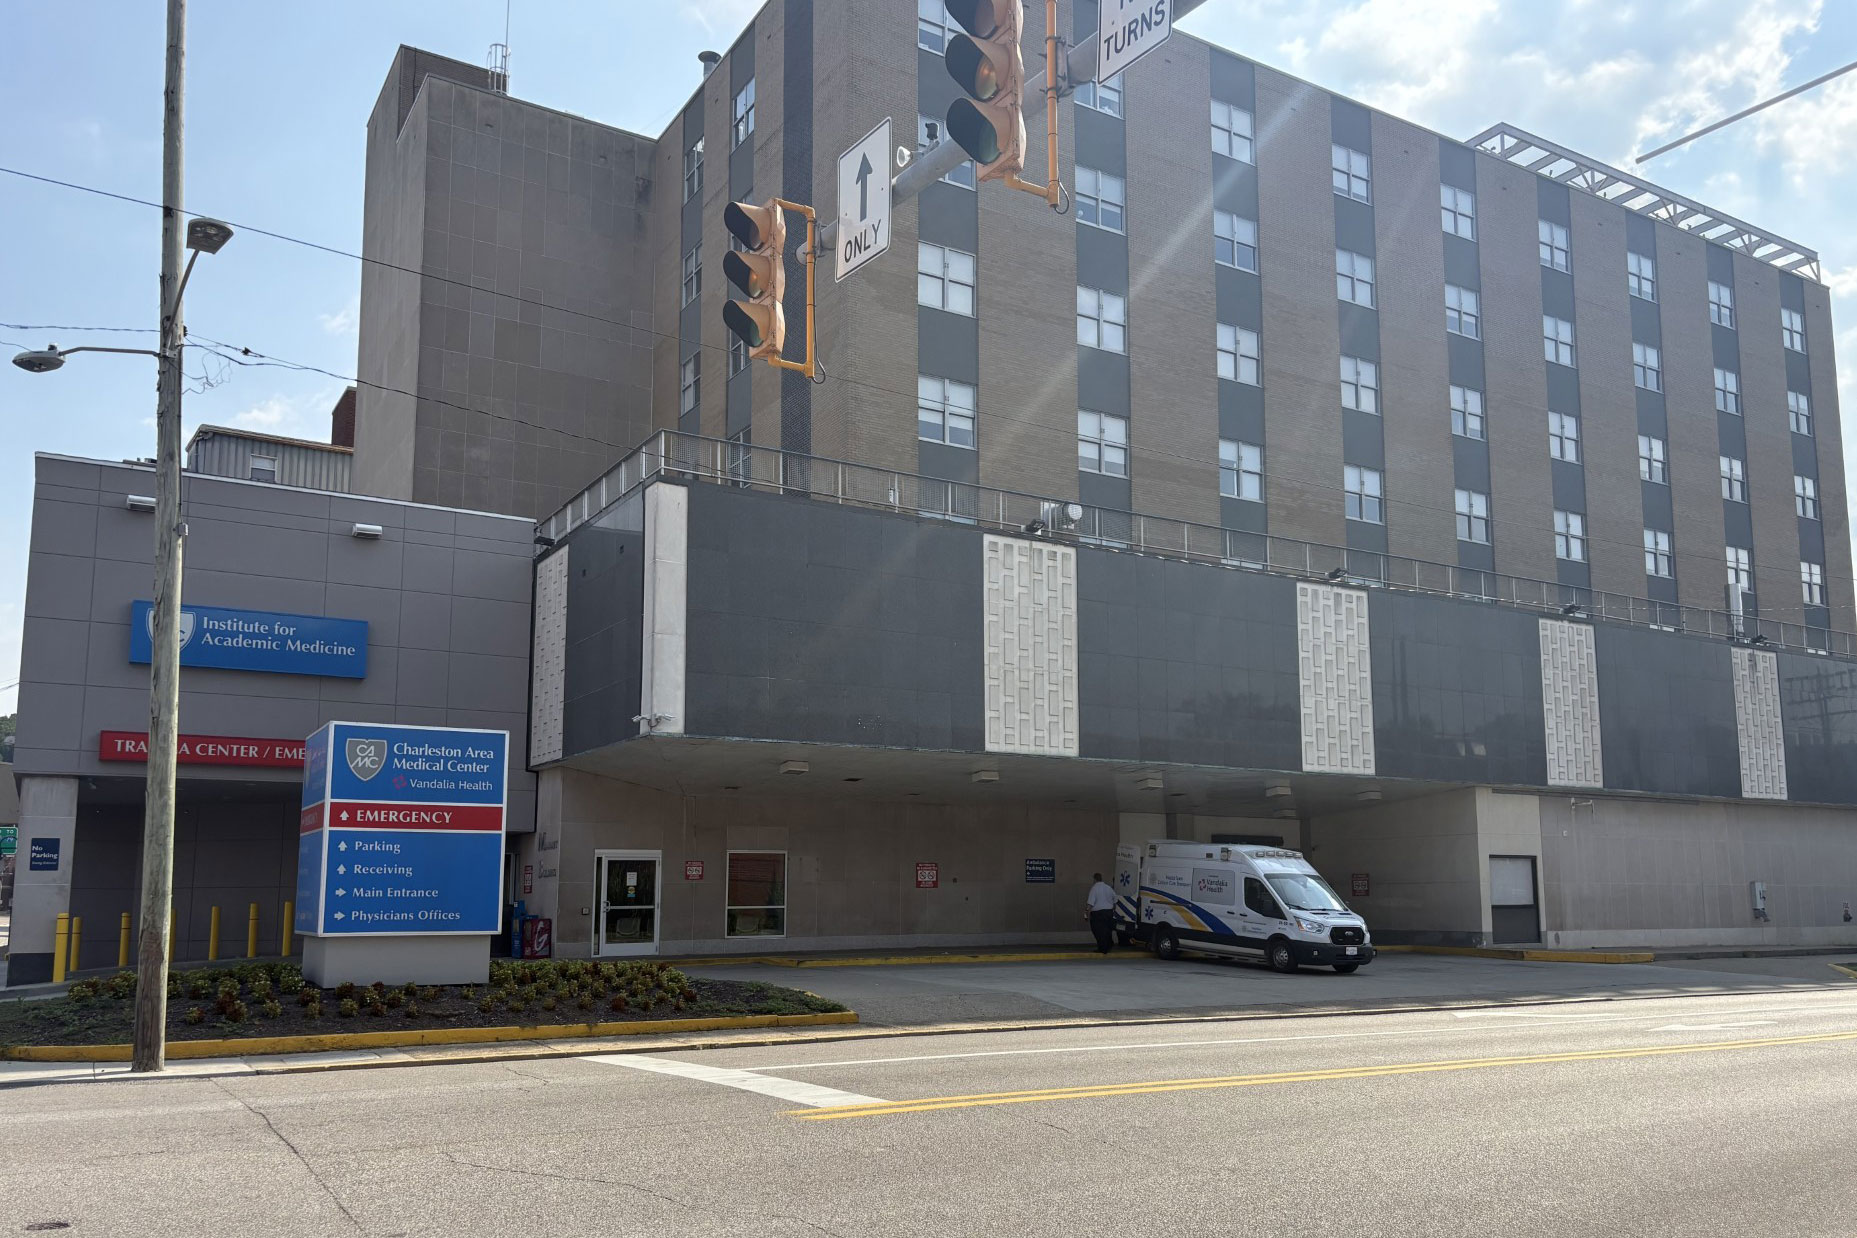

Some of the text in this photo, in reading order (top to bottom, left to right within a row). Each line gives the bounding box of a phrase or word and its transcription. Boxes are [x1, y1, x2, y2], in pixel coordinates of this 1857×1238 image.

[1103, 0, 1166, 61] TURNS
[844, 218, 882, 263] ONLY
[203, 616, 297, 636] Institute for
[201, 632, 281, 651] Academic
[285, 638, 356, 656] Medicine
[114, 739, 190, 755] TRAA
[195, 742, 259, 758] CENTER
[393, 742, 494, 759] Charleston Area
[392, 757, 490, 773] Medical Center
[409, 778, 493, 791] Vandalia Health
[356, 809, 453, 823] EMERGENCY
[355, 840, 401, 854] Parking
[354, 863, 413, 878] Receiving
[352, 887, 439, 898] Main Entrance
[351, 909, 461, 924] Physicians Offices
